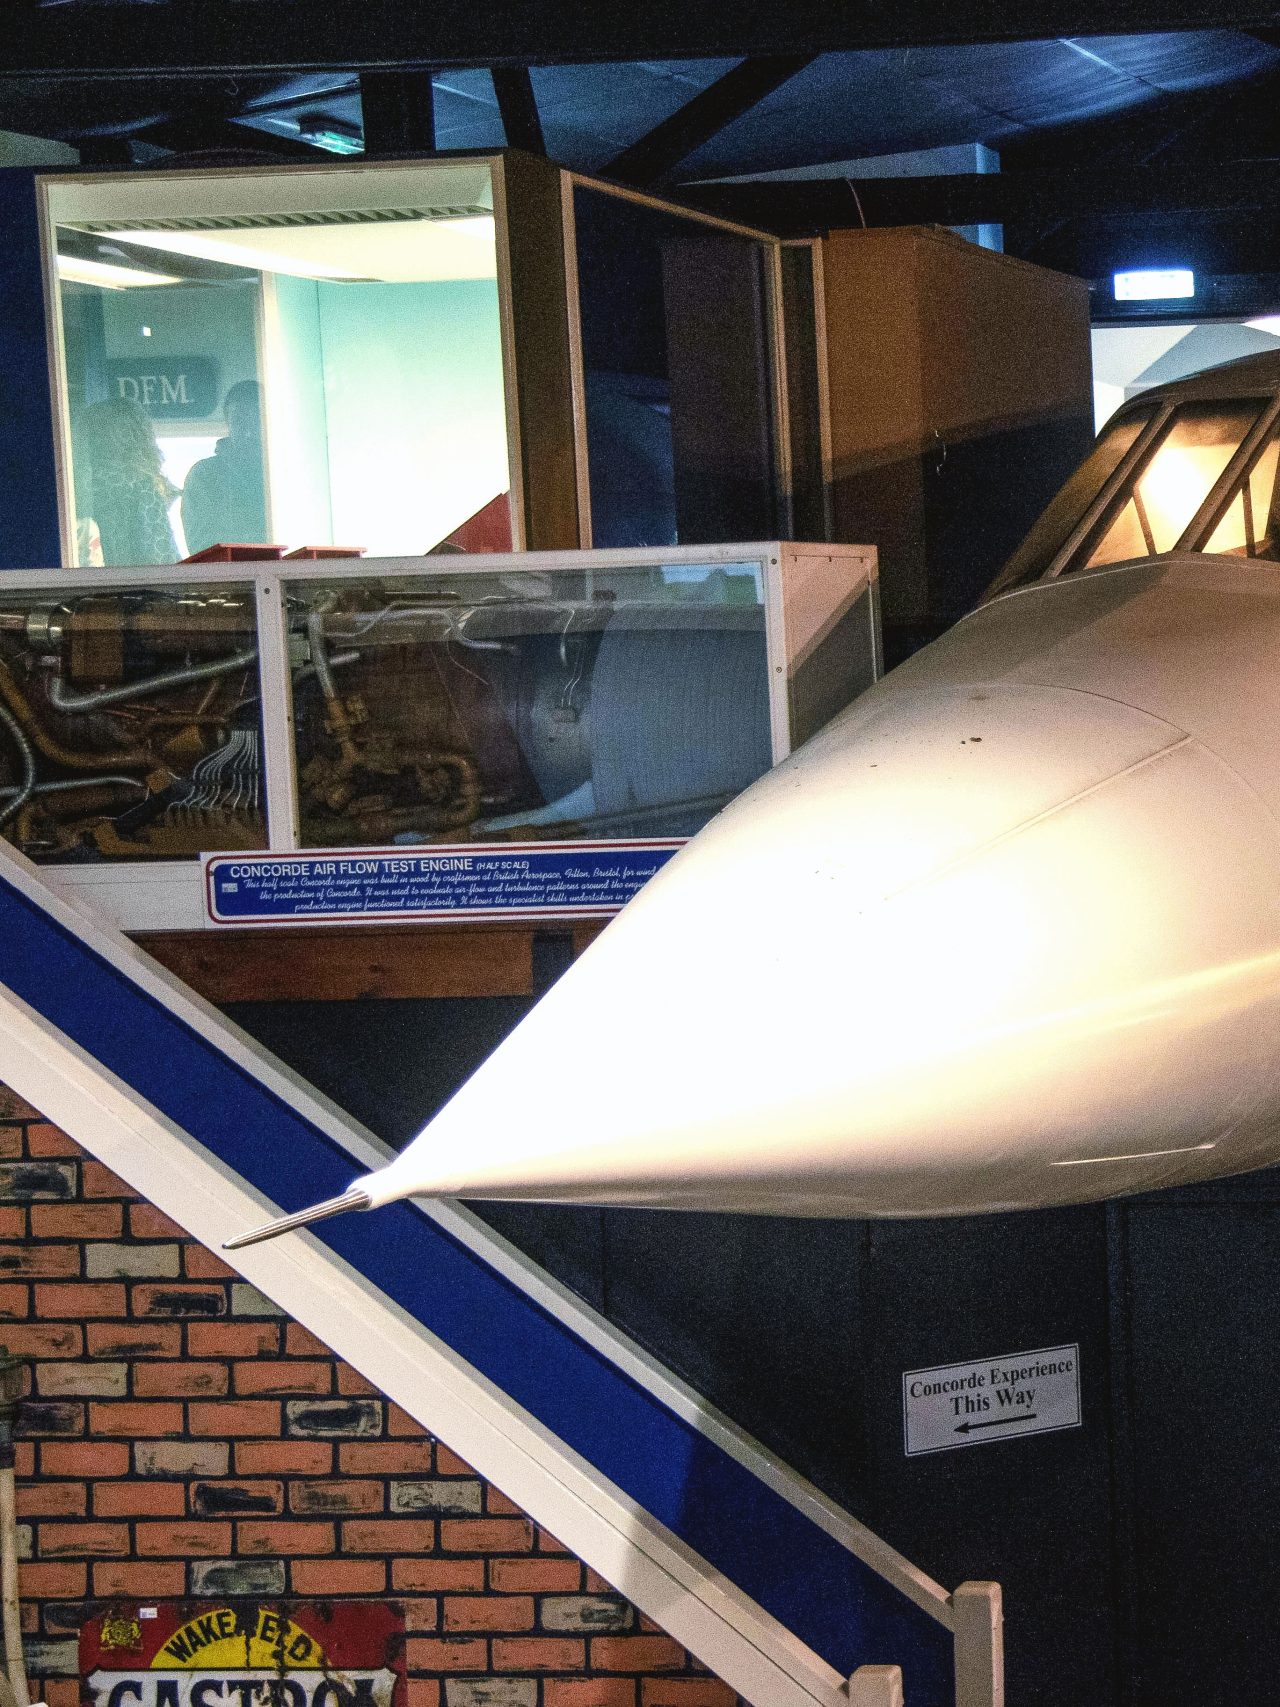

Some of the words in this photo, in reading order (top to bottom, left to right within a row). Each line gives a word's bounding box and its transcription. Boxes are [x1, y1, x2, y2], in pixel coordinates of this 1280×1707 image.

[229, 864, 310, 878] CONCORDE
[313, 863, 336, 875] AIR
[339, 861, 379, 873] FLOW
[381, 860, 416, 872] TEST
[420, 858, 473, 870] ENGINE
[910, 1372, 986, 1398] Concorde
[990, 1360, 1073, 1386] Experience
[950, 1394, 990, 1416] This
[996, 1387, 1037, 1409] Way
